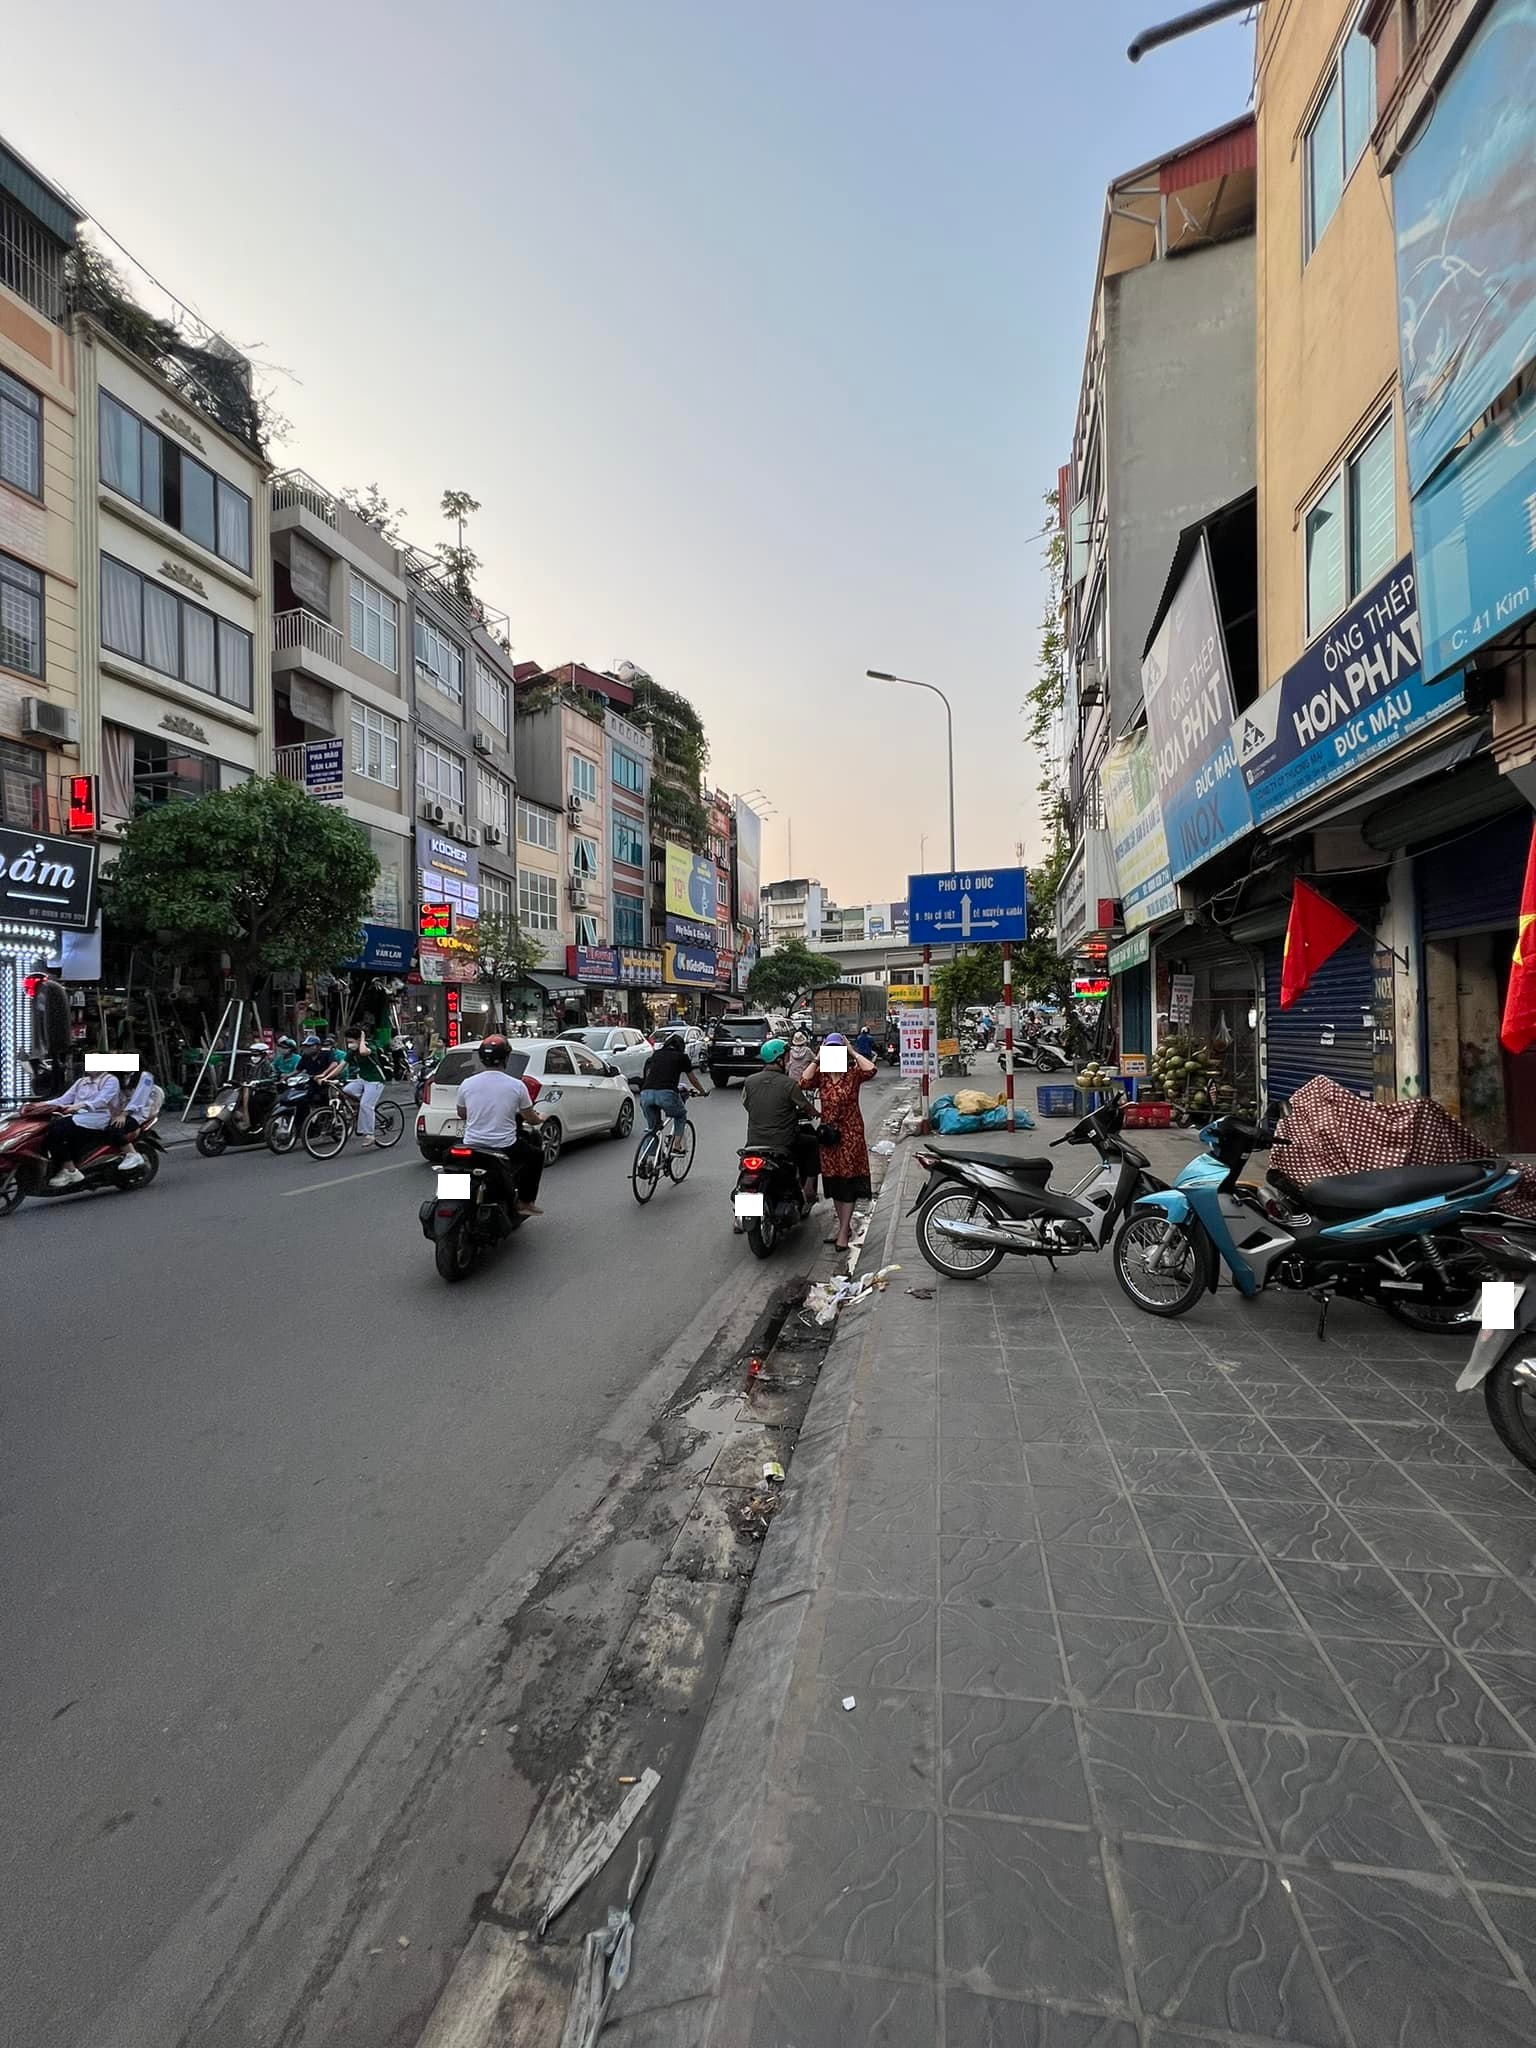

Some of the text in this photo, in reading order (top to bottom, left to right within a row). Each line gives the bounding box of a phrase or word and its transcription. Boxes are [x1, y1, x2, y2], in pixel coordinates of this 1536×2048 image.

[1323, 573, 1414, 673] ỐNG THÉP
[1472, 609, 1490, 635] 41
[1496, 586, 1530, 621] Kim
[1189, 636, 1214, 690] THÉP
[1334, 721, 1369, 758] ĐỨC
[1368, 689, 1412, 731] MẬU
[1195, 765, 1215, 799] ĐỨC
[1214, 745, 1238, 779] MẬU
[431, 839, 467, 862] KÖCHER
[1180, 792, 1225, 861] INOX
[0, 844, 76, 889] ẩm
[938, 876, 957, 892] PHỐ
[960, 876, 971, 890] LÒ
[905, 1038, 922, 1050] 15
